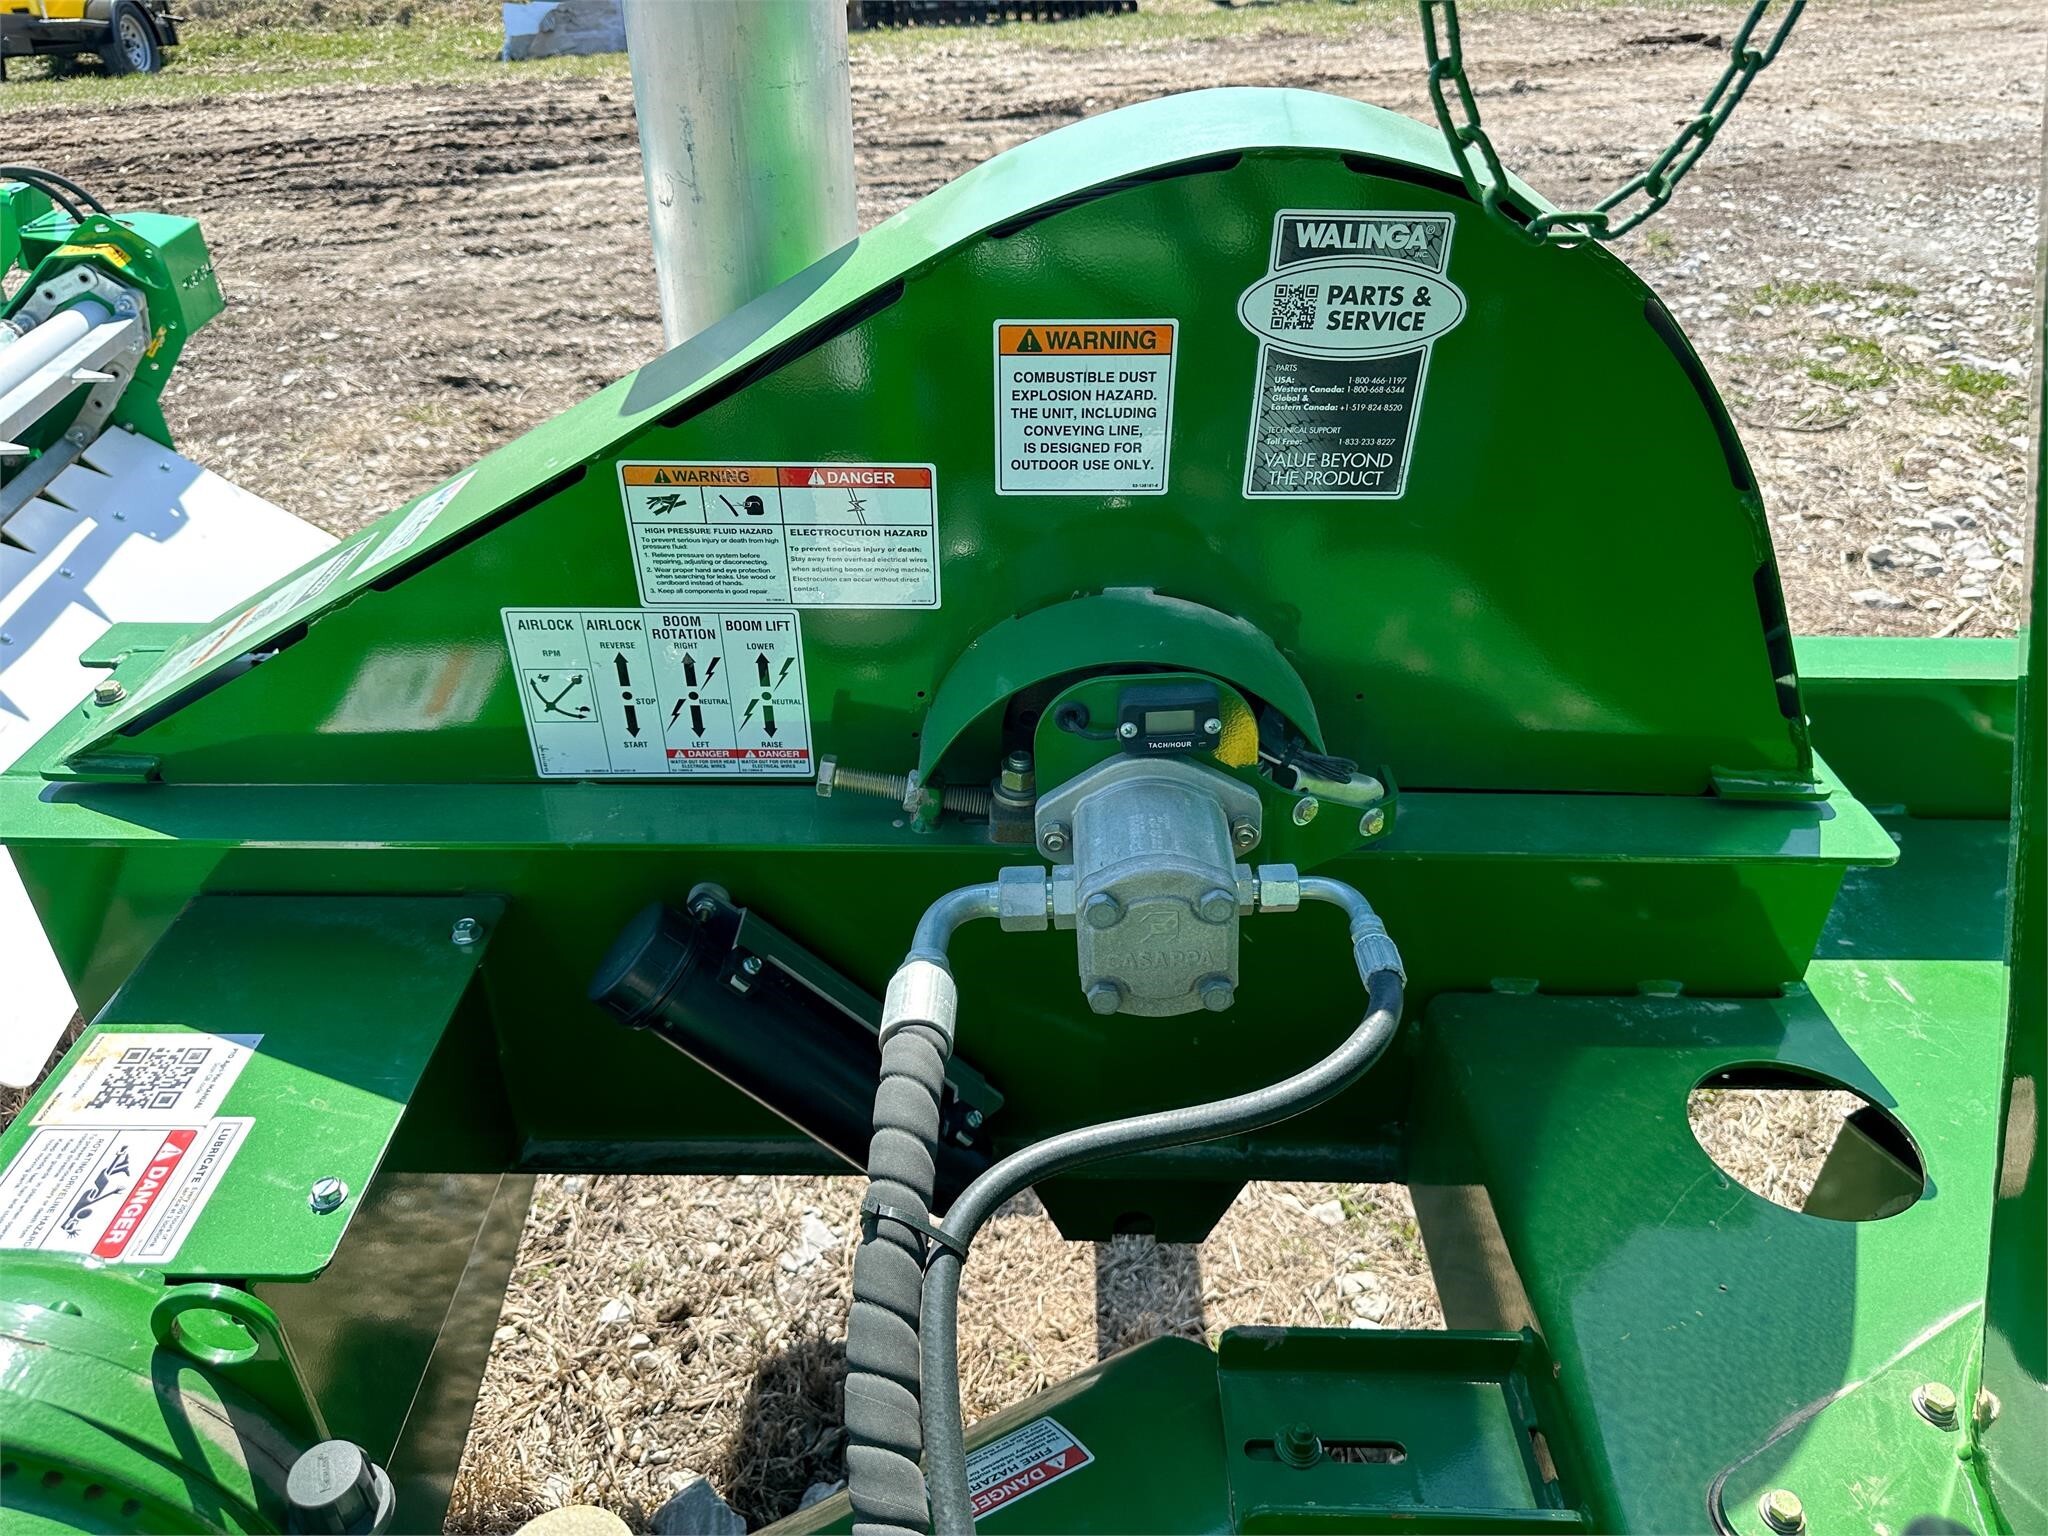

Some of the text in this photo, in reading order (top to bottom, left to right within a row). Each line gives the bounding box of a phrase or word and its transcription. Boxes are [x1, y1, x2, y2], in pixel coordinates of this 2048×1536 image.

[1327, 285, 1432, 306] PARTS &
[1326, 311, 1426, 332] SERVICE
[1045, 330, 1158, 350] WARNING
[1014, 372, 1157, 383] COMBUSTIBLE DUST
[1012, 390, 1157, 401] EXPLOSION HAZARD.
[1011, 408, 1157, 420] THE UNIT, INCLUDING
[1024, 426, 1142, 438] CONVEYING LINE,
[1024, 442, 1142, 453] IS DESIGNED FOR
[1011, 460, 1154, 470] OUTDOOR USE ONLY.
[1264, 453, 1393, 468] VALUE BEYOND
[672, 470, 750, 483] WARNING
[827, 472, 896, 484] DANGER
[1270, 471, 1384, 486] THE PRODUCT
[518, 620, 574, 631] AIRLOCK
[586, 620, 642, 631] AIRLOCK
[663, 616, 701, 626] BOOM
[725, 620, 790, 631] BOOM LIFT
[652, 629, 716, 640] ROTATION
[1106, 950, 1214, 968] CASAPPA
[191, 1128, 232, 1184] LUBRICATE
[24, 1138, 104, 1247] ROTATING DRIVELINE HAZARD
[104, 1166, 169, 1244] DANGER
[969, 1447, 1052, 1493] FIRE HAZAR
